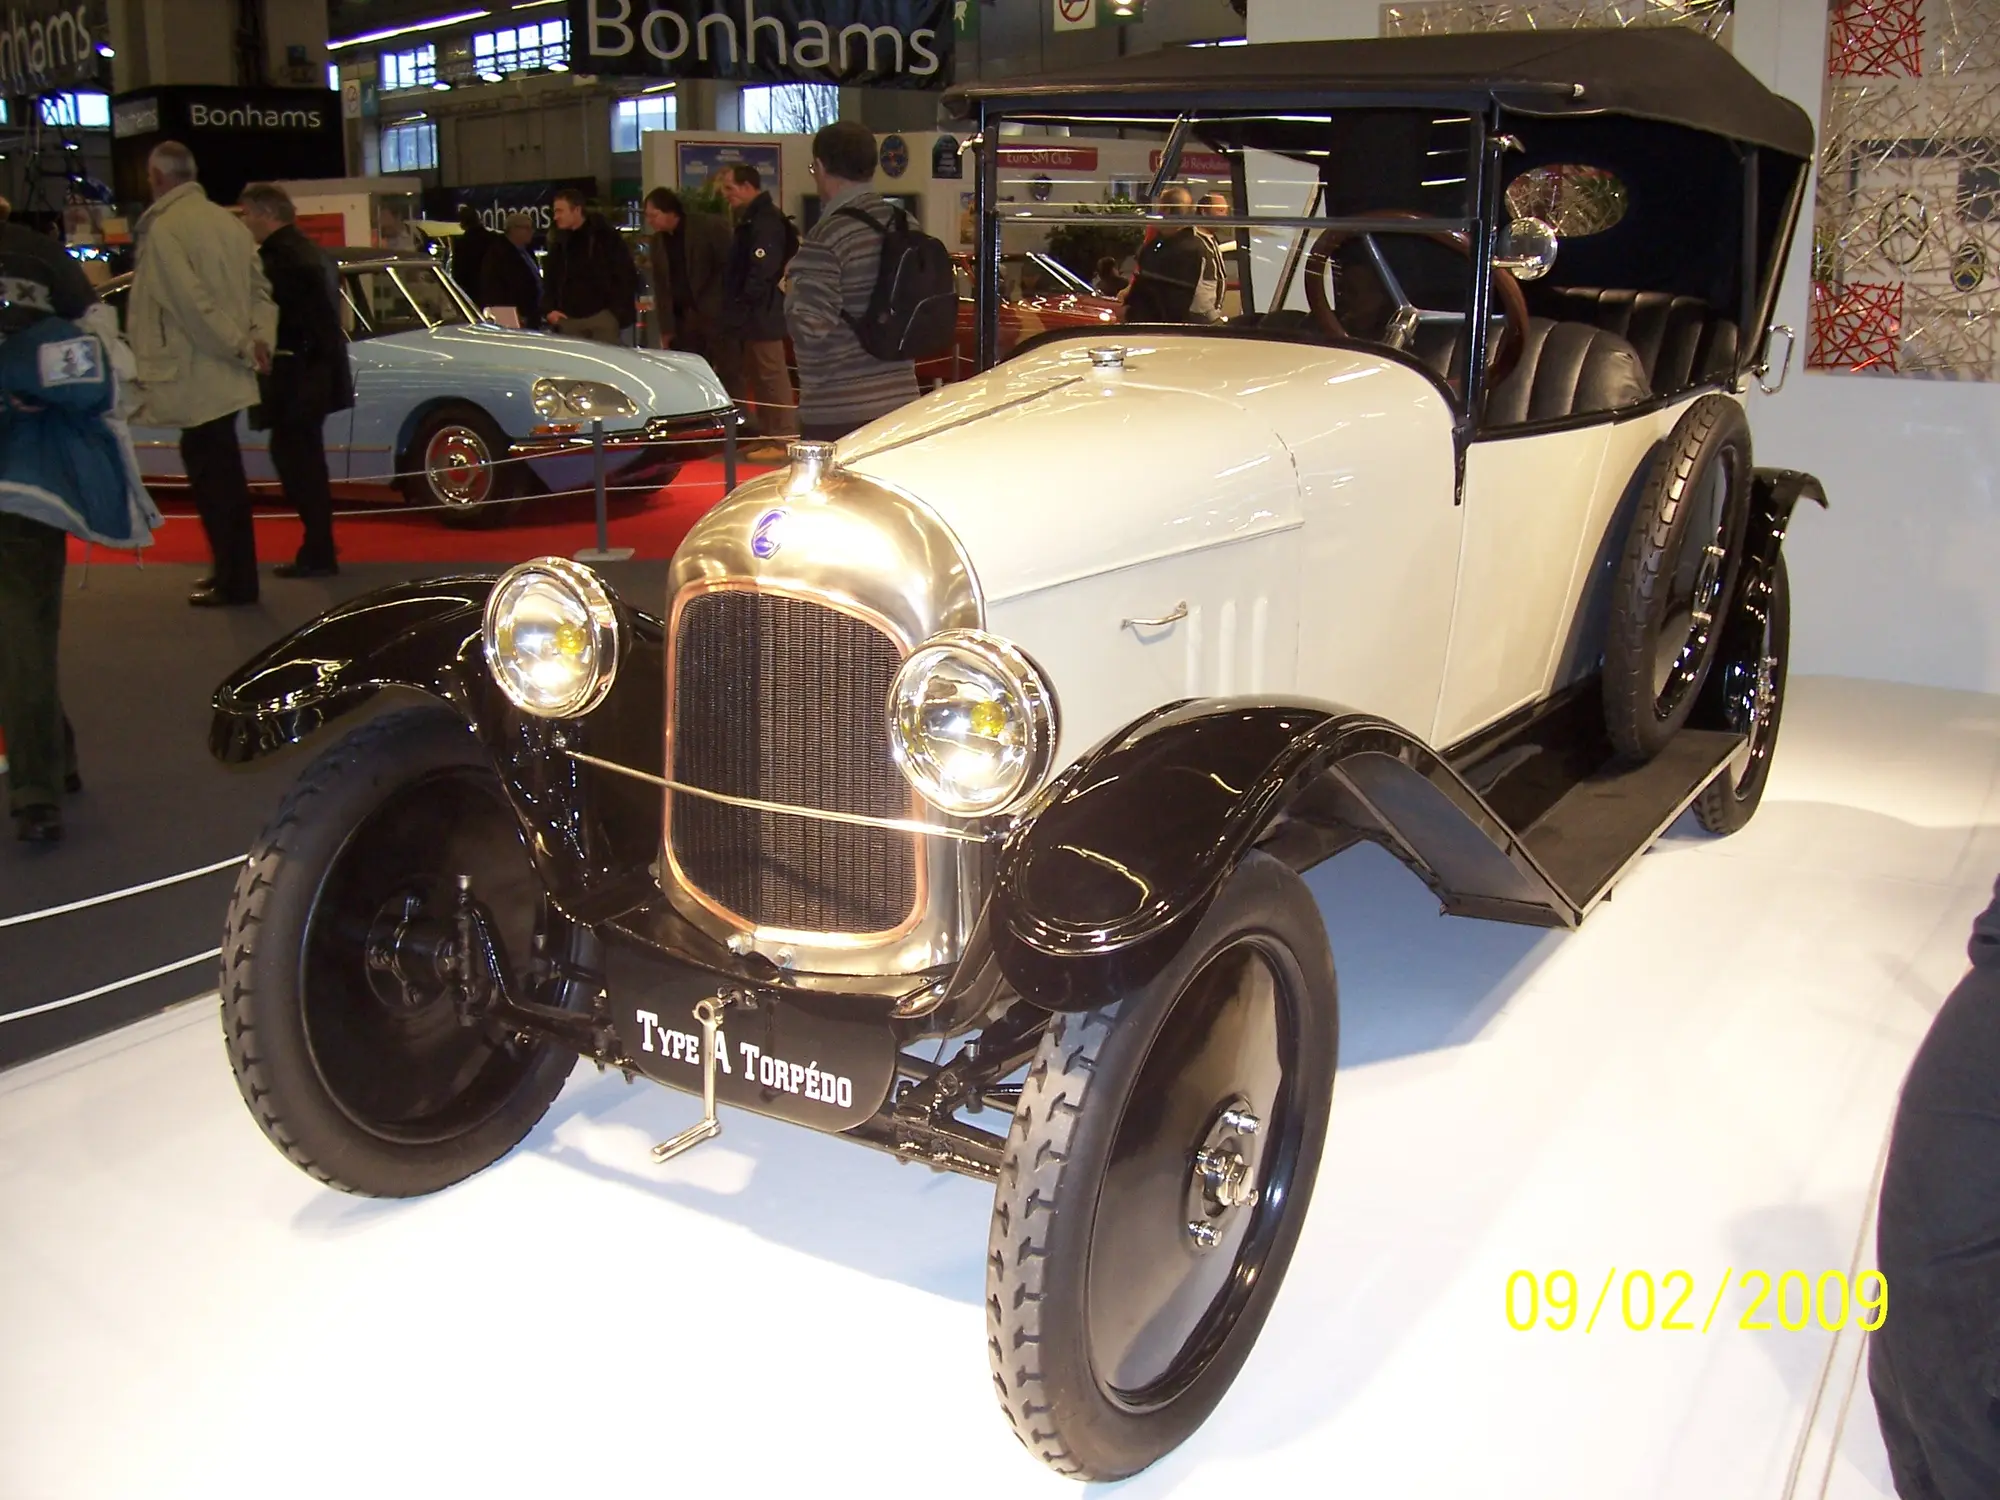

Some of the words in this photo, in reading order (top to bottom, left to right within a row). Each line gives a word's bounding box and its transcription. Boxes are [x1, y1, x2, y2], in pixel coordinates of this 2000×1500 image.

[588, 0, 941, 76] Bonhams
[190, 103, 322, 129] Bonhams
[1031, 151, 1049, 165] SM
[1051, 151, 1073, 166] Club
[713, 1030, 732, 1074] A
